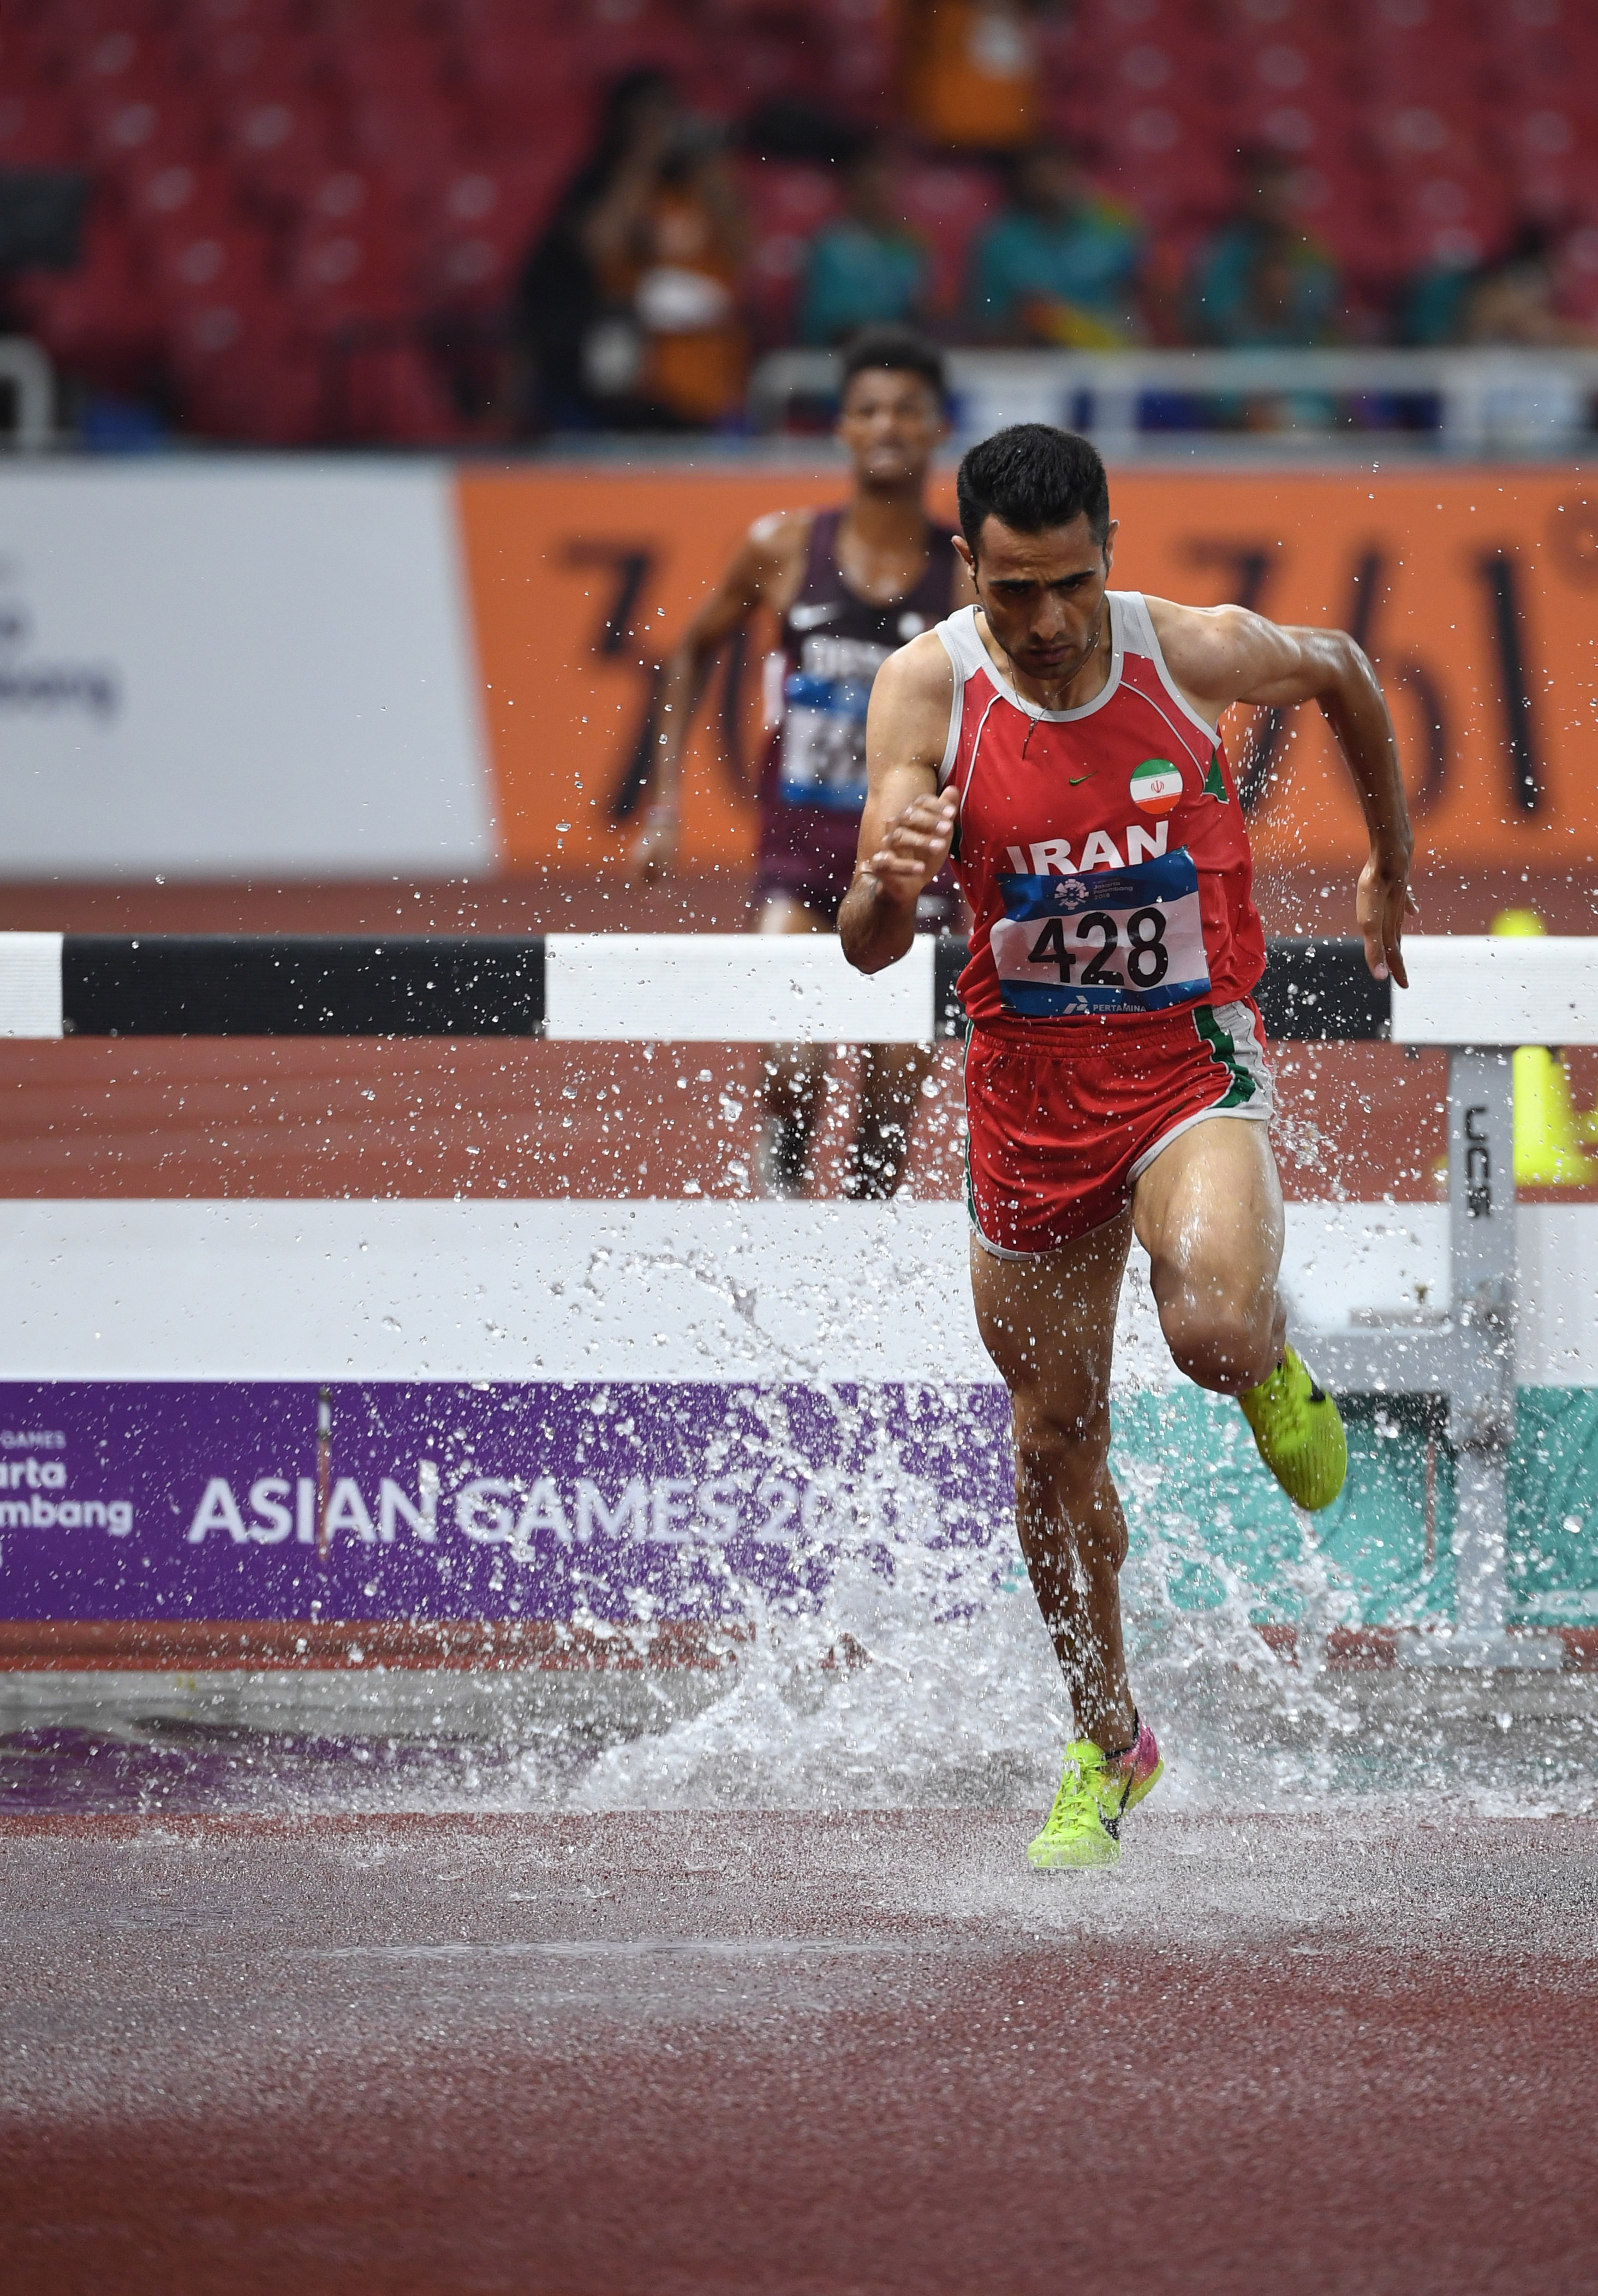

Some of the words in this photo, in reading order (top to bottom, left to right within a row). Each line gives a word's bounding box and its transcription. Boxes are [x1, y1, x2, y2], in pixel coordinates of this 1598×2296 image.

[1006, 820, 1168, 876] IRAN
[1028, 907, 1168, 988] 428
[1093, 1004, 1147, 1012] PERTAMINA
[187, 1477, 438, 1544] ASIAN
[455, 1475, 738, 1543] GAMES
